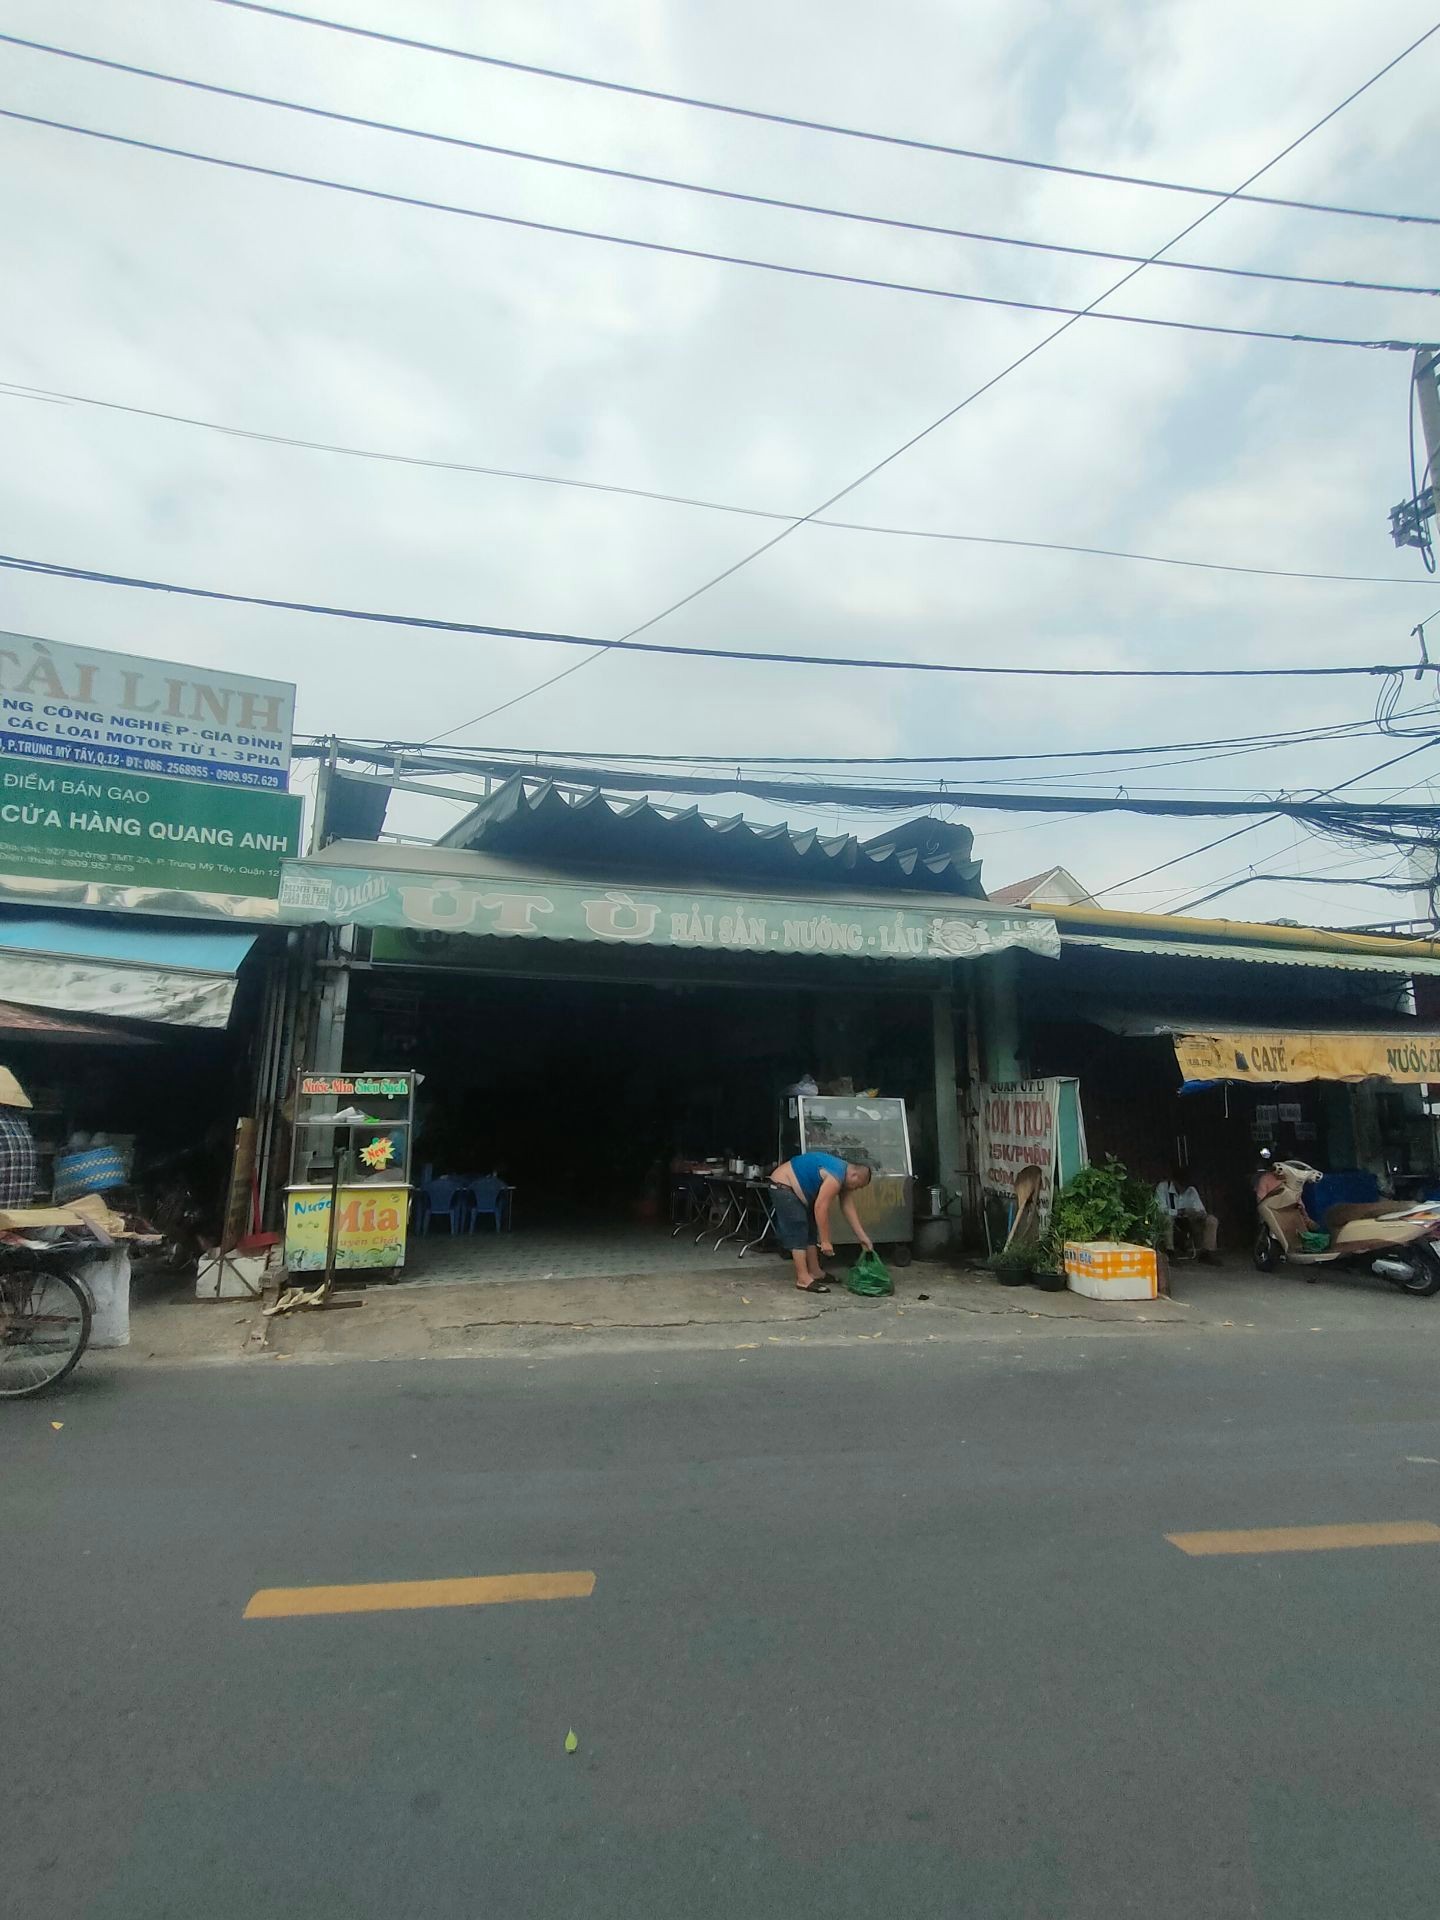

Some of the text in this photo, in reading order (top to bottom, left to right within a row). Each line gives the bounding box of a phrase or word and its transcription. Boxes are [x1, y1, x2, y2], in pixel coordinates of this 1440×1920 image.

[120, 669, 285, 734] LINH
[8, 716, 48, 732] CÁC
[55, 723, 99, 742] LOẠI
[106, 731, 173, 750] MOTOR
[180, 742, 203, 755] TỪ
[43, 705, 104, 723] CÔNG
[237, 733, 283, 751] ĐÌNH
[55, 744, 72, 759] MỸ
[216, 769, 279, 787] 0909.957.629
[4, 772, 150, 804] ĐIỂM BÁN GẠO
[1, 802, 288, 852] CỬA HÀNG QUANG ANH
[168, 859, 196, 870] Trung
[199, 861, 215, 872] Mỹ
[239, 866, 265, 877] Quận
[268, 869, 280, 877] 12
[335, 873, 390, 911] Quán
[581, 891, 662, 939] Ù
[670, 903, 714, 942] HẢI
[719, 906, 767, 945] SẢN
[783, 914, 864, 951] NƯỚNG
[879, 911, 923, 954] LẨU
[1251, 1039, 1288, 1072] CAFÉ
[1387, 1041, 1440, 1073] NƯỚC É
[355, 1078, 380, 1094] Siêu
[380, 1078, 408, 1100] Sạch
[367, 1146, 387, 1160] New
